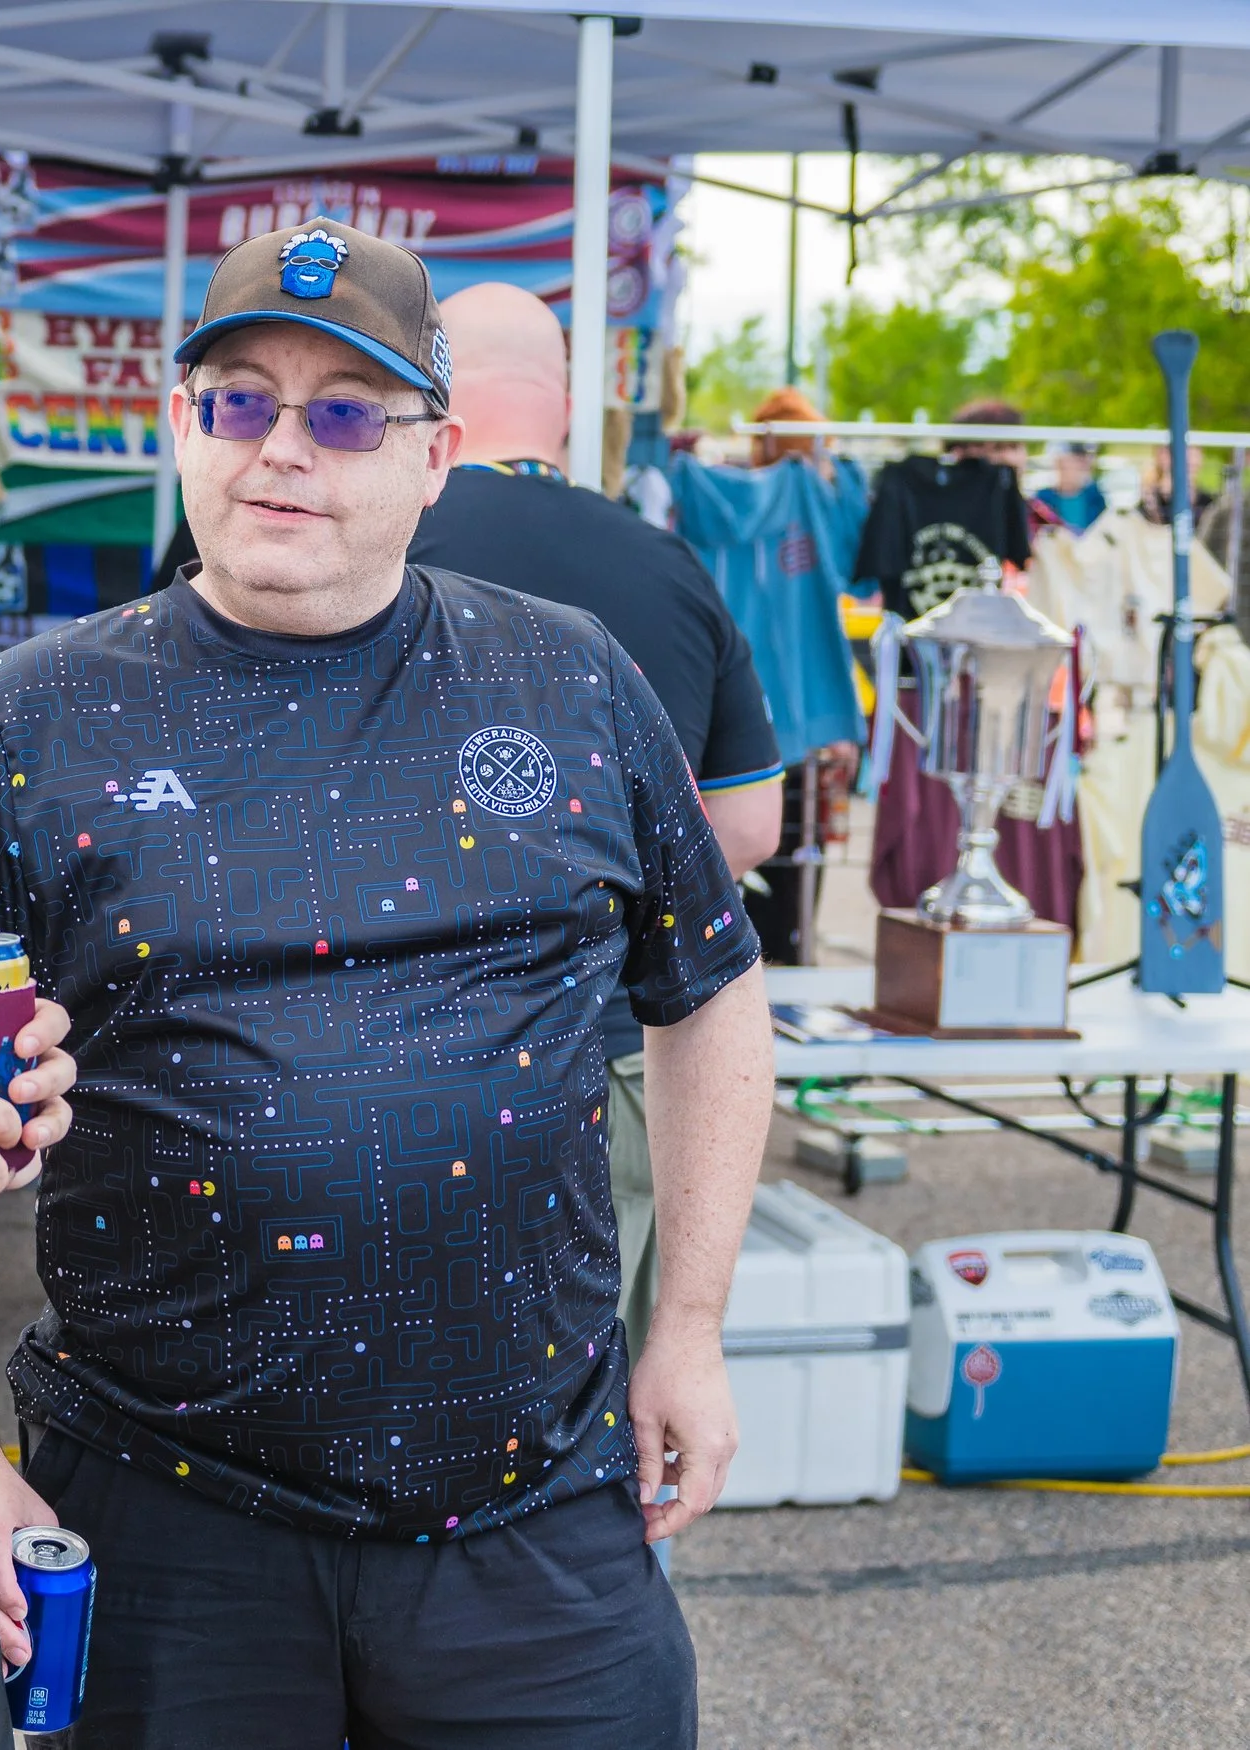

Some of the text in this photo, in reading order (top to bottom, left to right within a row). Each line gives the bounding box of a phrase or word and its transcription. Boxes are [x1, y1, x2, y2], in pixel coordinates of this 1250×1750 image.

[43, 312, 163, 348] EVE
[82, 355, 162, 387] FA
[7, 393, 162, 455] CENT
[464, 729, 548, 761] NEWCRAIGHALL
[466, 777, 553, 813] LEITH VICTORIA AFC
[33, 1689, 45, 1698] 150
